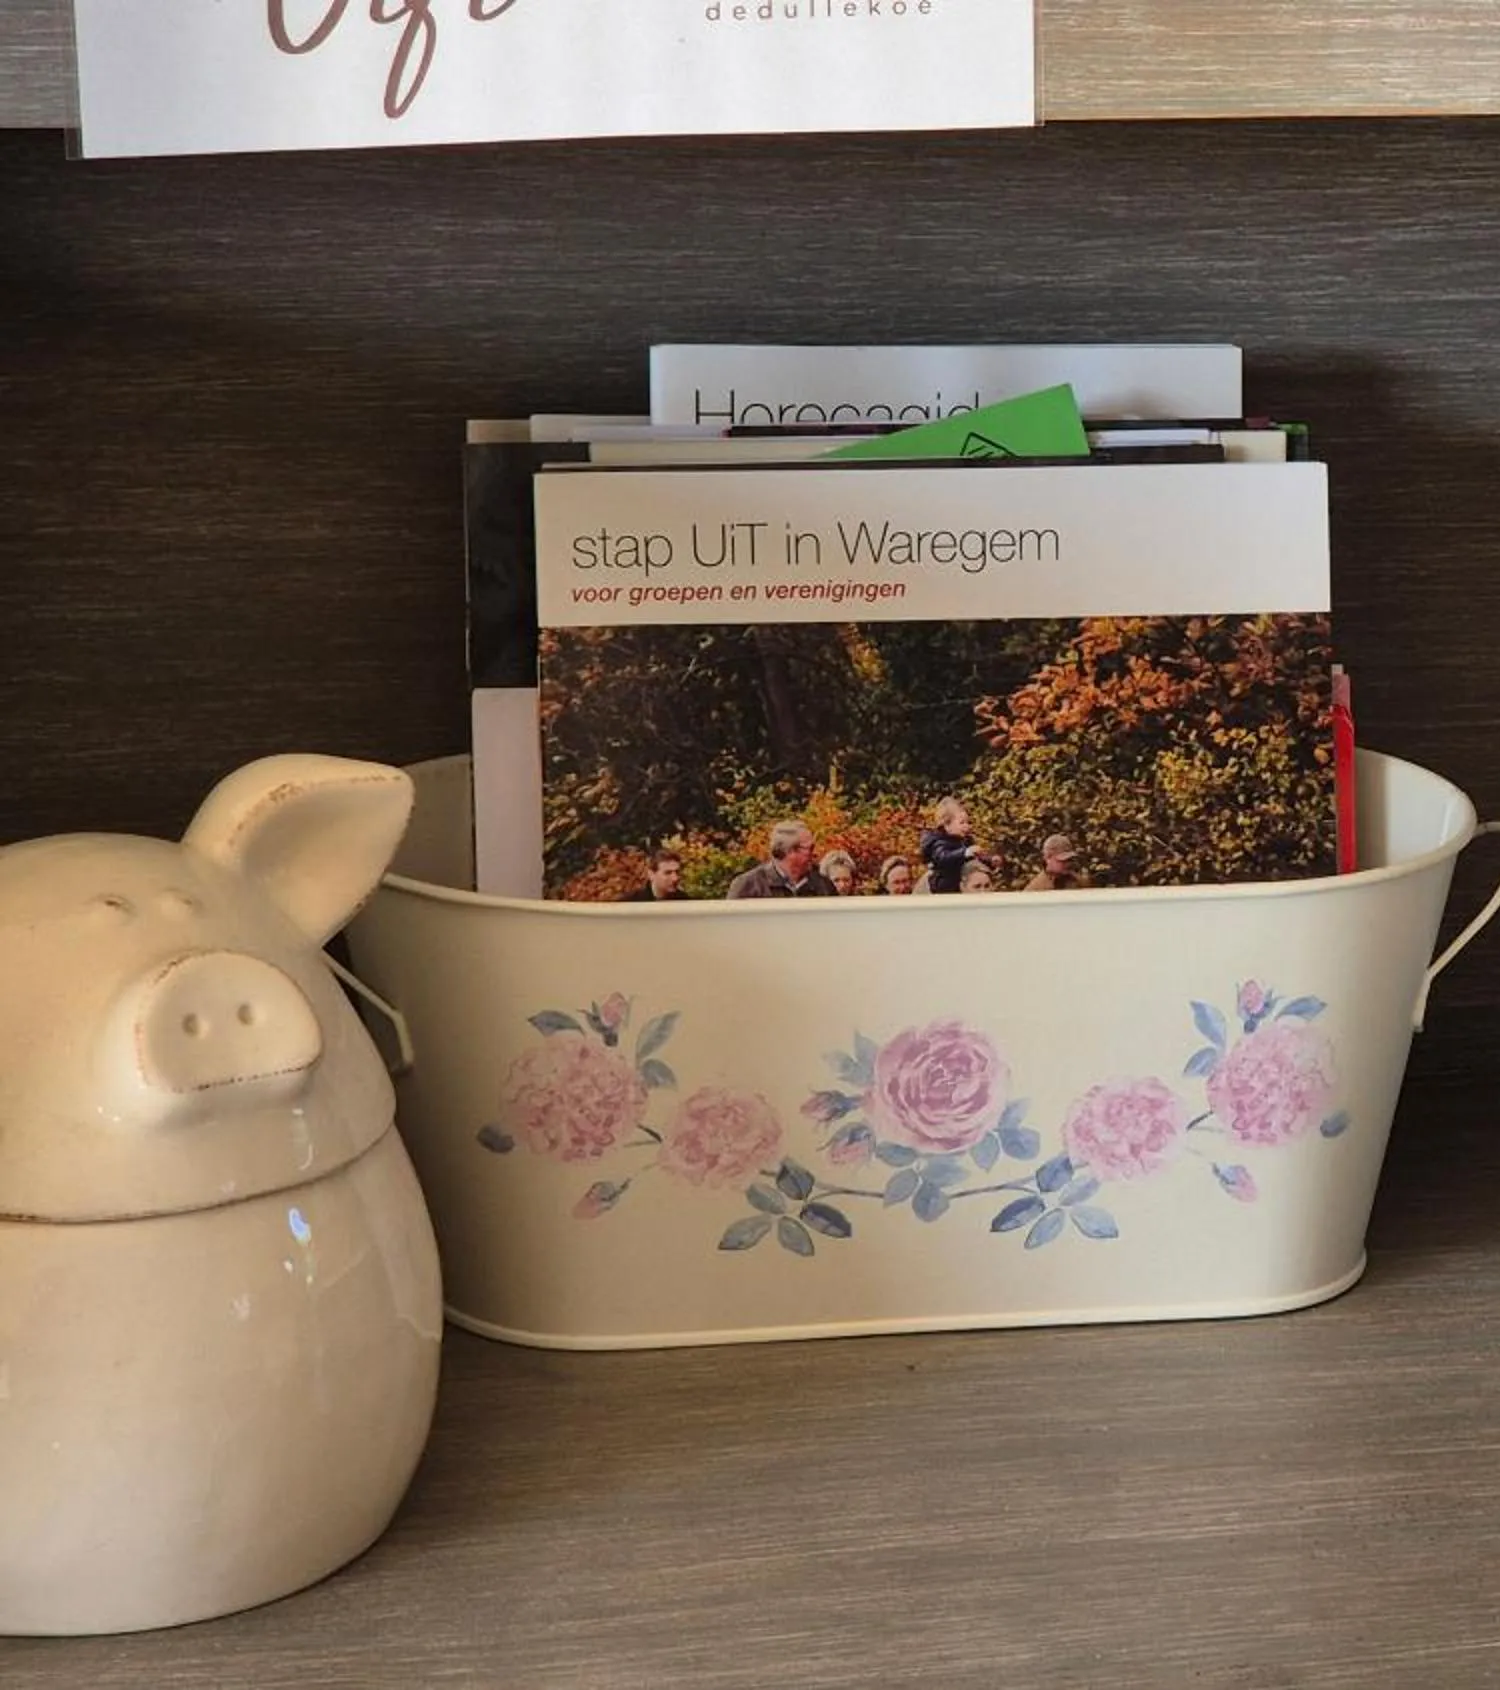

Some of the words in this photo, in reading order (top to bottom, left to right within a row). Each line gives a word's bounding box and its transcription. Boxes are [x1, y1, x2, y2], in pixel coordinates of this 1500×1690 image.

[705, 0, 932, 21] dedullekoe
[572, 527, 673, 577] stap
[692, 522, 768, 567] UiT
[785, 522, 821, 565] in
[836, 520, 1060, 574] Waregem
[572, 586, 622, 602] voor
[628, 584, 723, 606] groepen
[730, 584, 757, 600] en
[764, 579, 906, 603] verenigingen
